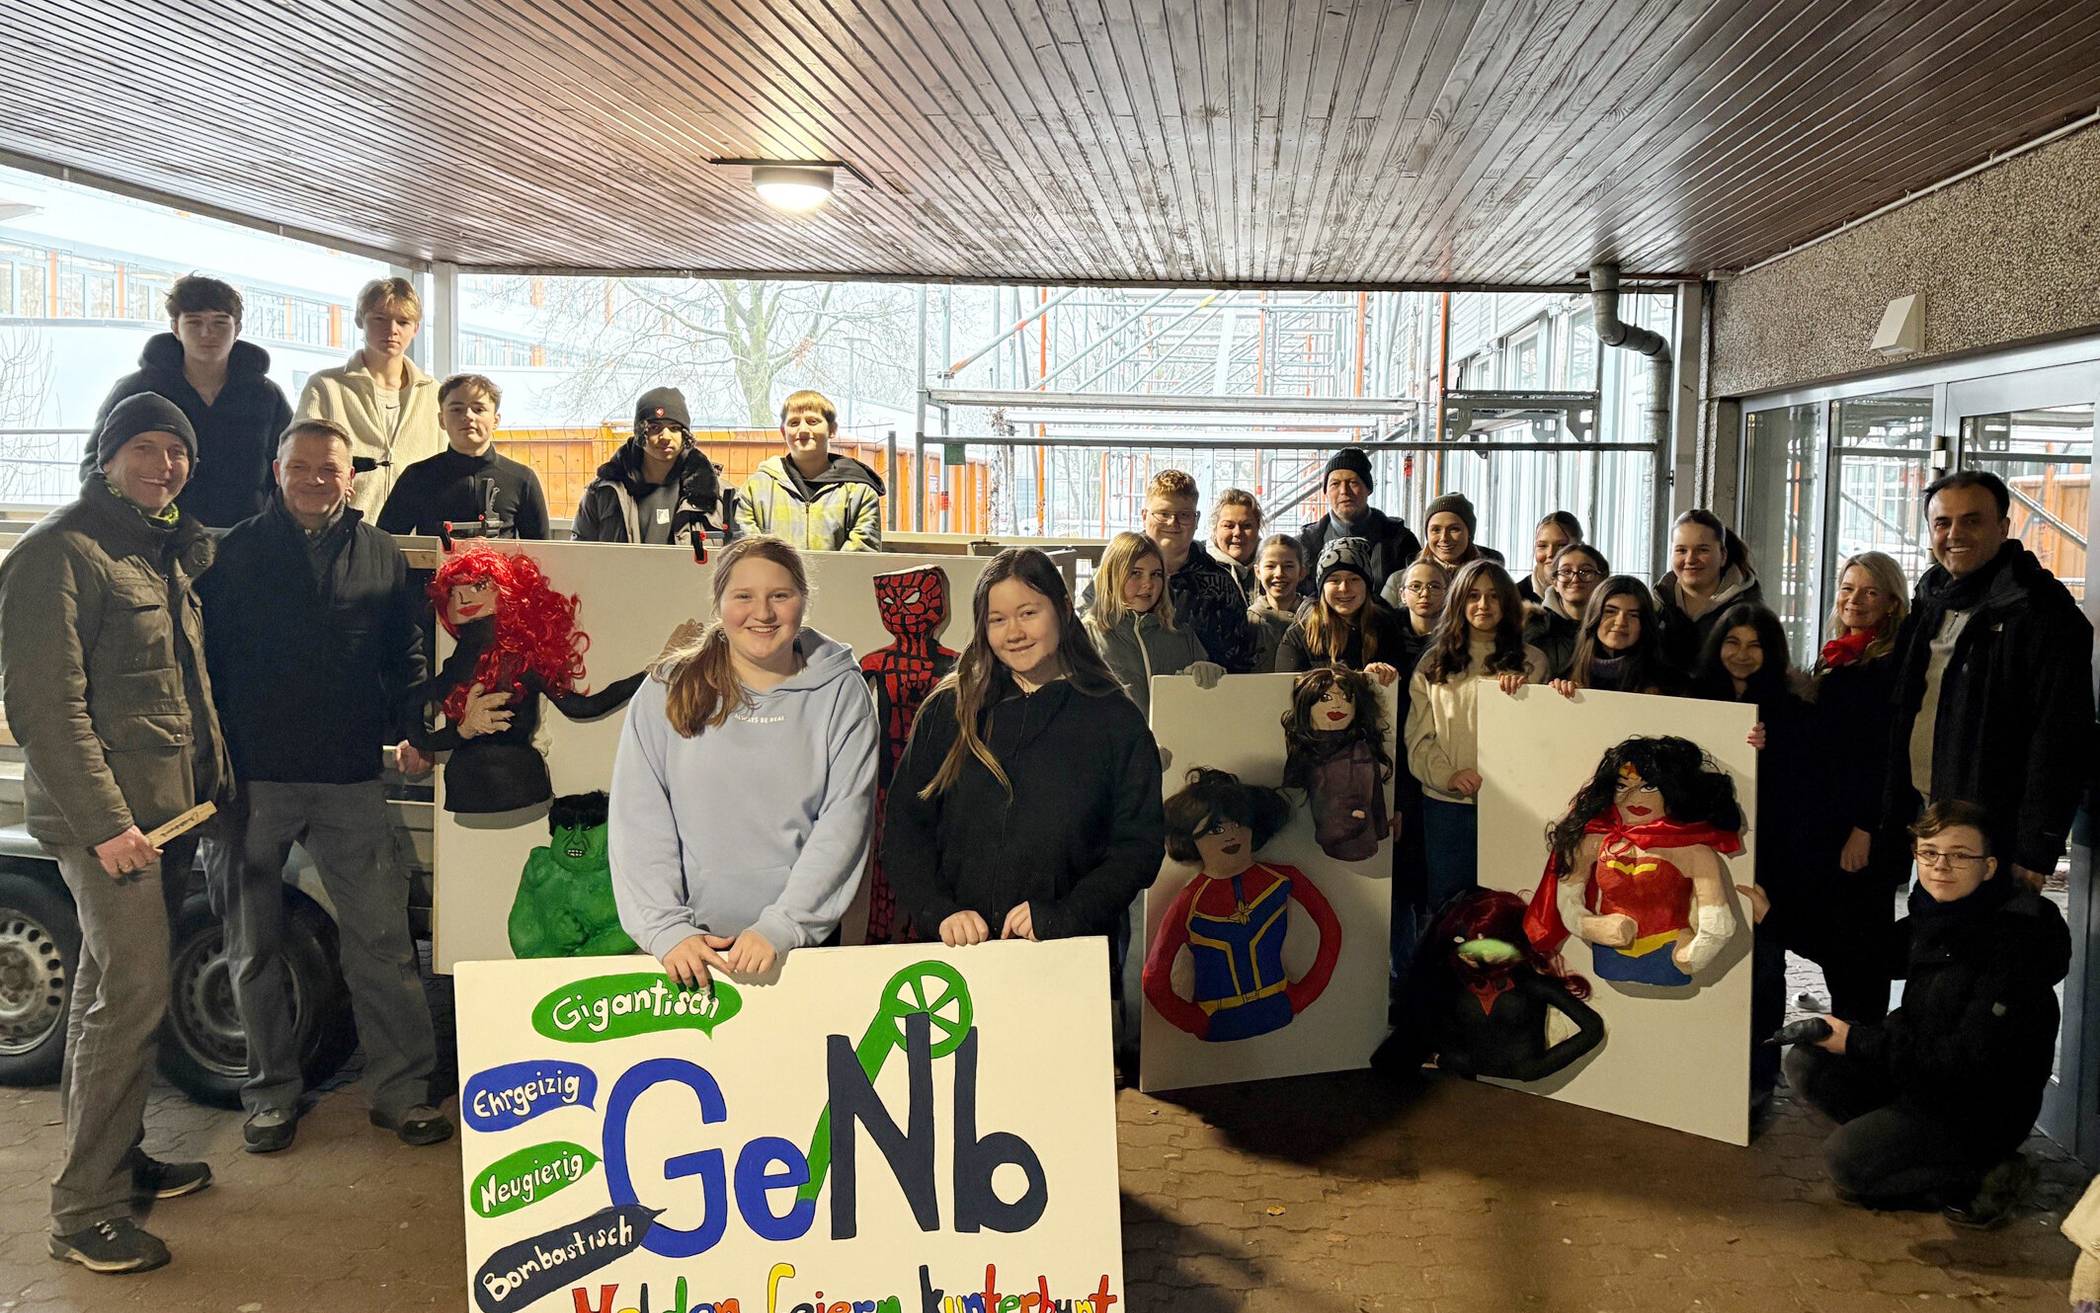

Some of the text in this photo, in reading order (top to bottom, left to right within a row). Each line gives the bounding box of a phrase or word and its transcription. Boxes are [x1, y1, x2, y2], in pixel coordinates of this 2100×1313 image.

[552, 979, 719, 1032] Gigantisch
[473, 1070, 580, 1117] Ehrgeizig
[480, 1151, 584, 1213] Neugierig
[482, 1215, 634, 1302] Bombastisch
